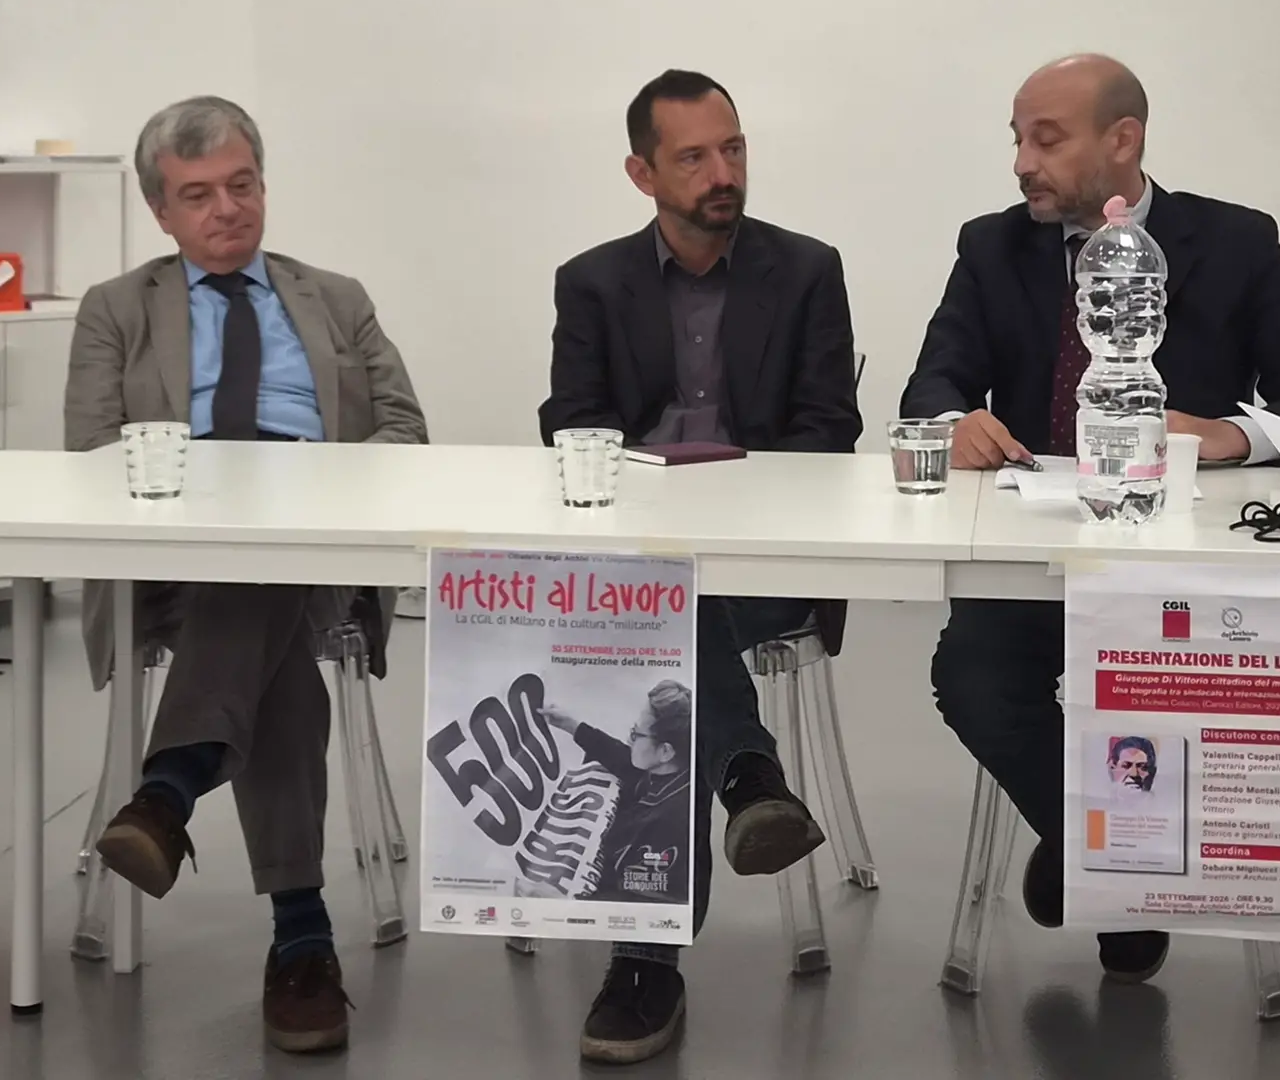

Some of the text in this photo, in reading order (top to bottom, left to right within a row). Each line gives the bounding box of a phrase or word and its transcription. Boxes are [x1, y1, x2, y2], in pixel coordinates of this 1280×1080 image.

[439, 569, 686, 618] Artisti al Lavoro
[1162, 601, 1191, 610] CGIL
[455, 614, 467, 624] La
[470, 614, 493, 625] CGIL
[497, 614, 507, 626] di
[510, 616, 546, 627] Milano
[548, 619, 556, 627] e
[558, 617, 568, 628] la
[571, 618, 606, 630] cultura
[564, 645, 614, 655] SETTEMBRE
[551, 655, 682, 667] Inaugurazione della mostra
[1098, 650, 1233, 668] PRESENTAZIONE
[1239, 655, 1269, 669] DEL
[1115, 674, 1159, 685] Giuseppe
[1162, 675, 1172, 684] Di
[1175, 676, 1208, 685] Vittorio
[1211, 677, 1252, 687] cittadino
[1254, 679, 1270, 687] del
[1112, 686, 1128, 694] Una
[1130, 687, 1167, 696] biografia
[1183, 689, 1223, 697] sindacato
[1202, 730, 1257, 740] Discutono
[1260, 732, 1280, 740] con
[426, 673, 560, 847] 500
[1202, 751, 1245, 760] Valentina
[1202, 762, 1245, 771] Segretaria
[1202, 772, 1247, 780] Lombardia
[1202, 785, 1280, 795] Edmondo Montali
[1202, 795, 1252, 804] Fondazione
[1202, 805, 1235, 814] Vittorio
[1202, 820, 1237, 828] Antonio
[1202, 829, 1232, 837] Storico
[1202, 845, 1251, 856] Coordina
[623, 872, 669, 882] STORIE IDEE
[623, 881, 669, 892] CONQUISTE
[1157, 893, 1207, 902] SETTEMBRE
